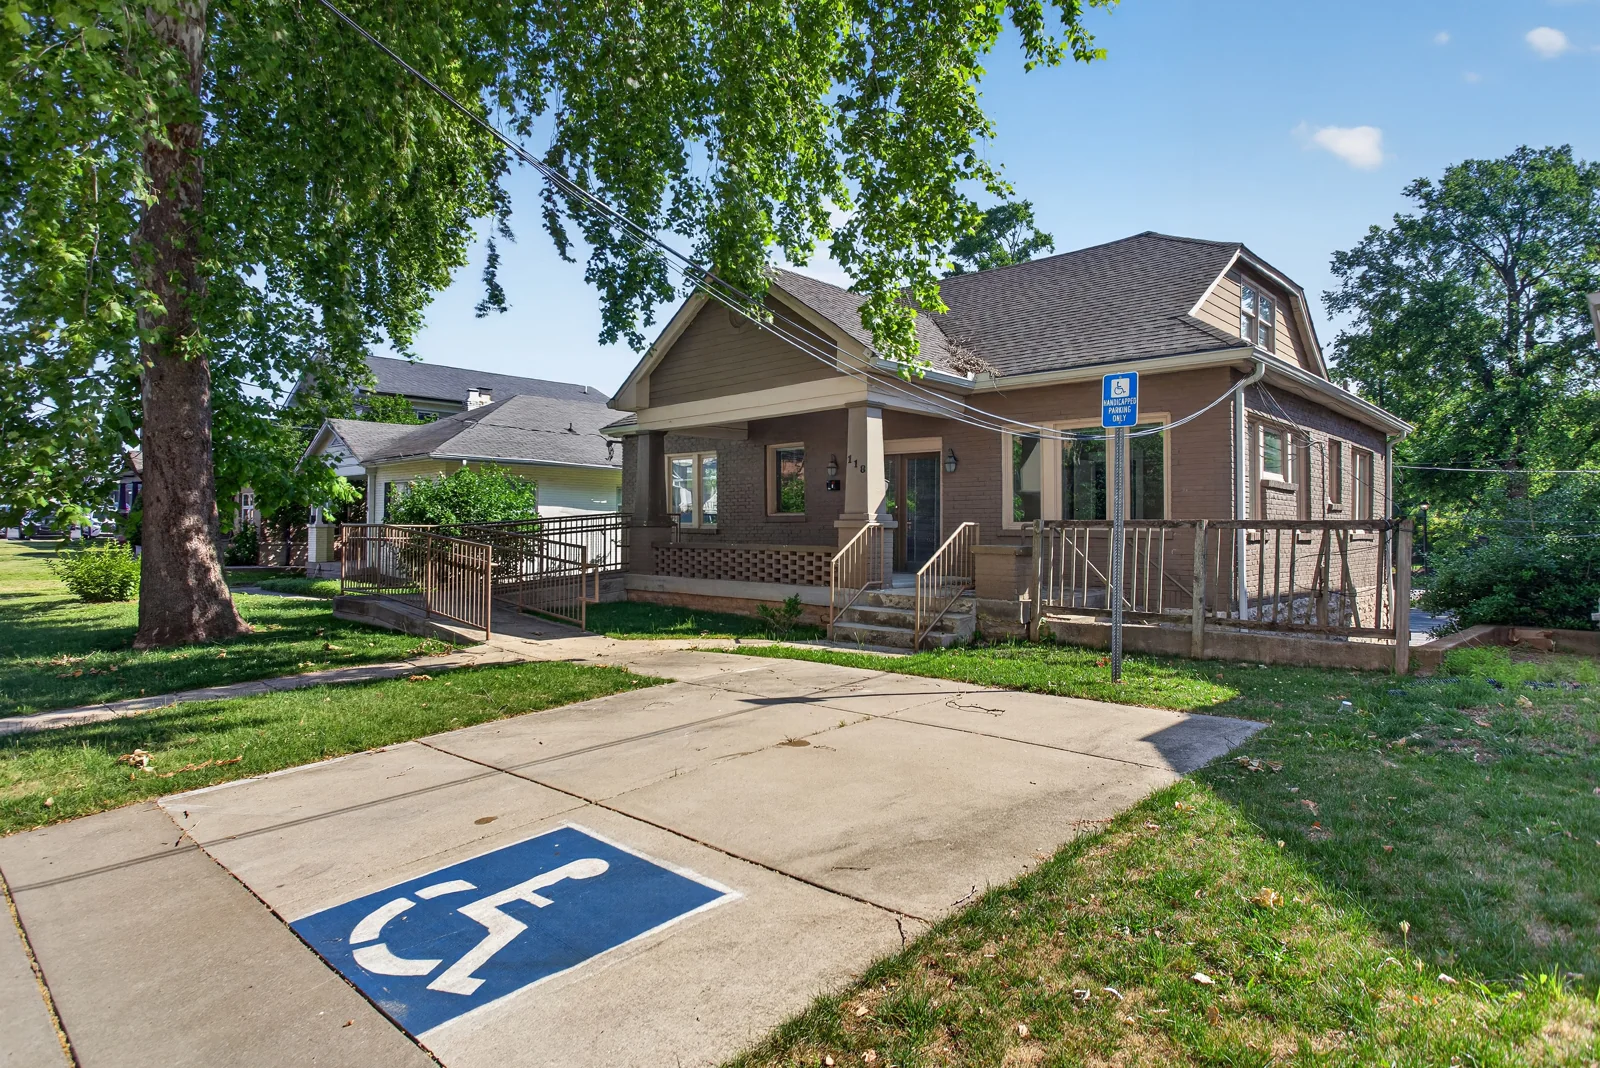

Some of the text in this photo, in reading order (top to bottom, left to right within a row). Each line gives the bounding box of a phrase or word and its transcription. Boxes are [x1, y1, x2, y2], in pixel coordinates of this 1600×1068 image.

[1103, 397, 1137, 406] HANDICAPPED
[1108, 406, 1131, 414] PARKING
[1112, 414, 1127, 422] ONLY
[847, 454, 866, 473] 118
